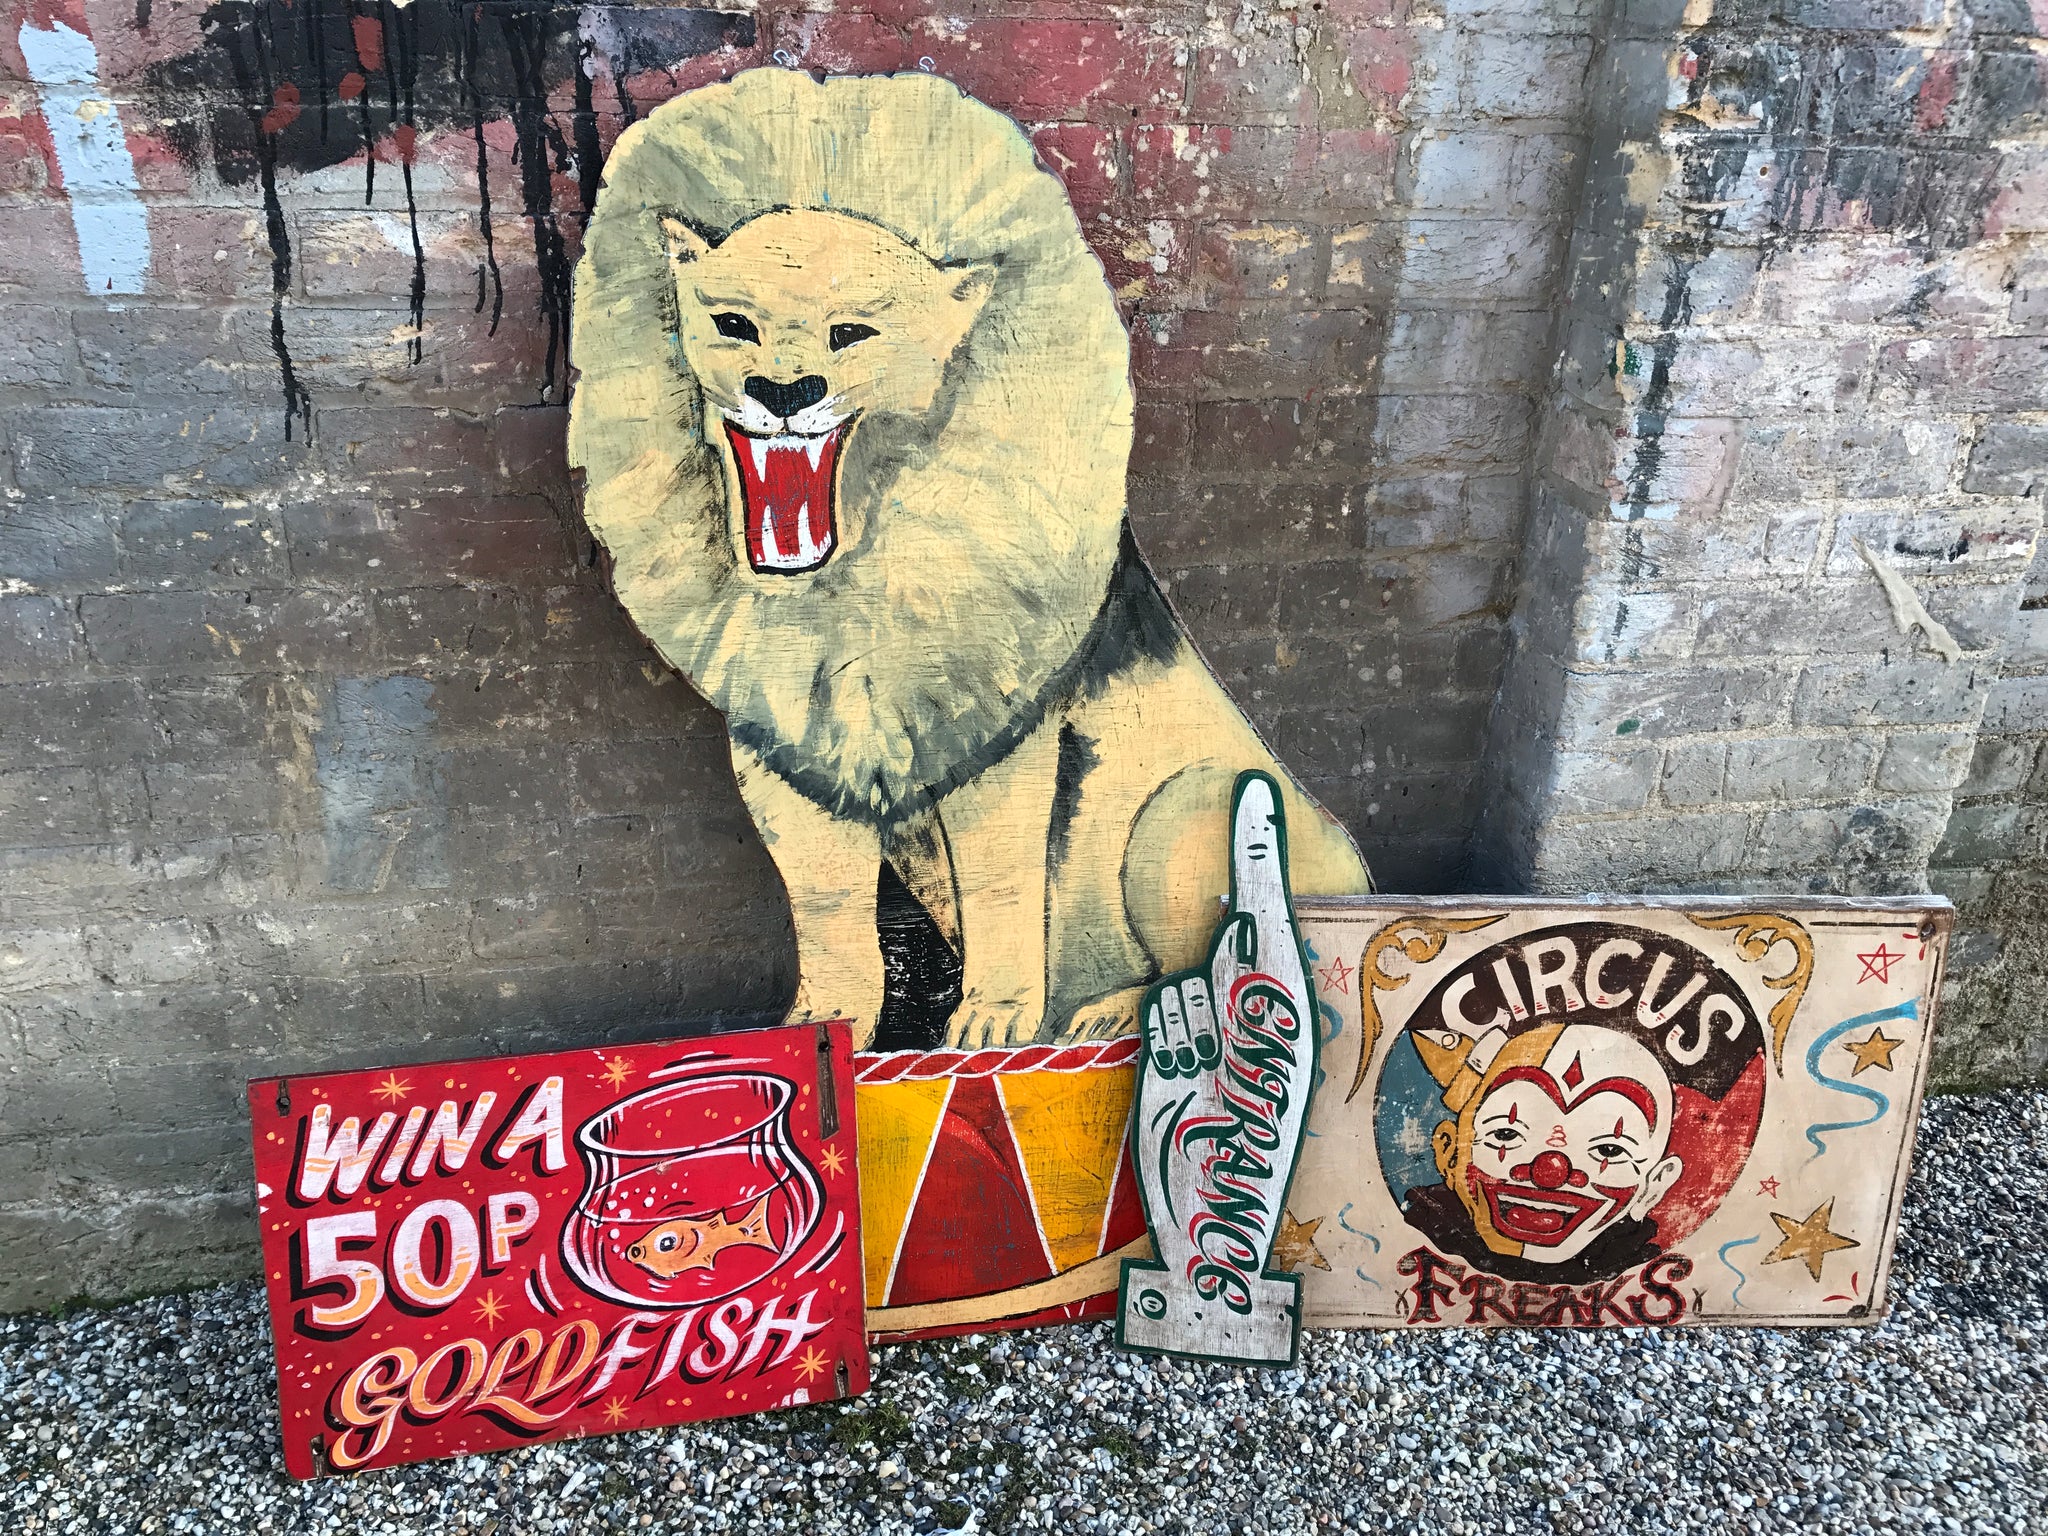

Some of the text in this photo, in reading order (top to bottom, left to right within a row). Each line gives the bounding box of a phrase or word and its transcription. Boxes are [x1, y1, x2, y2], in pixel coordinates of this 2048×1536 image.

[1441, 937, 1745, 1064] CIRCUS
[292, 1076, 569, 1204] WIN A
[1175, 972, 1300, 1315] ENTRANCE
[295, 1190, 540, 1338] 50P
[1397, 1248, 1694, 1327] FREAKS
[325, 1288, 834, 1470] GOLDFISH
